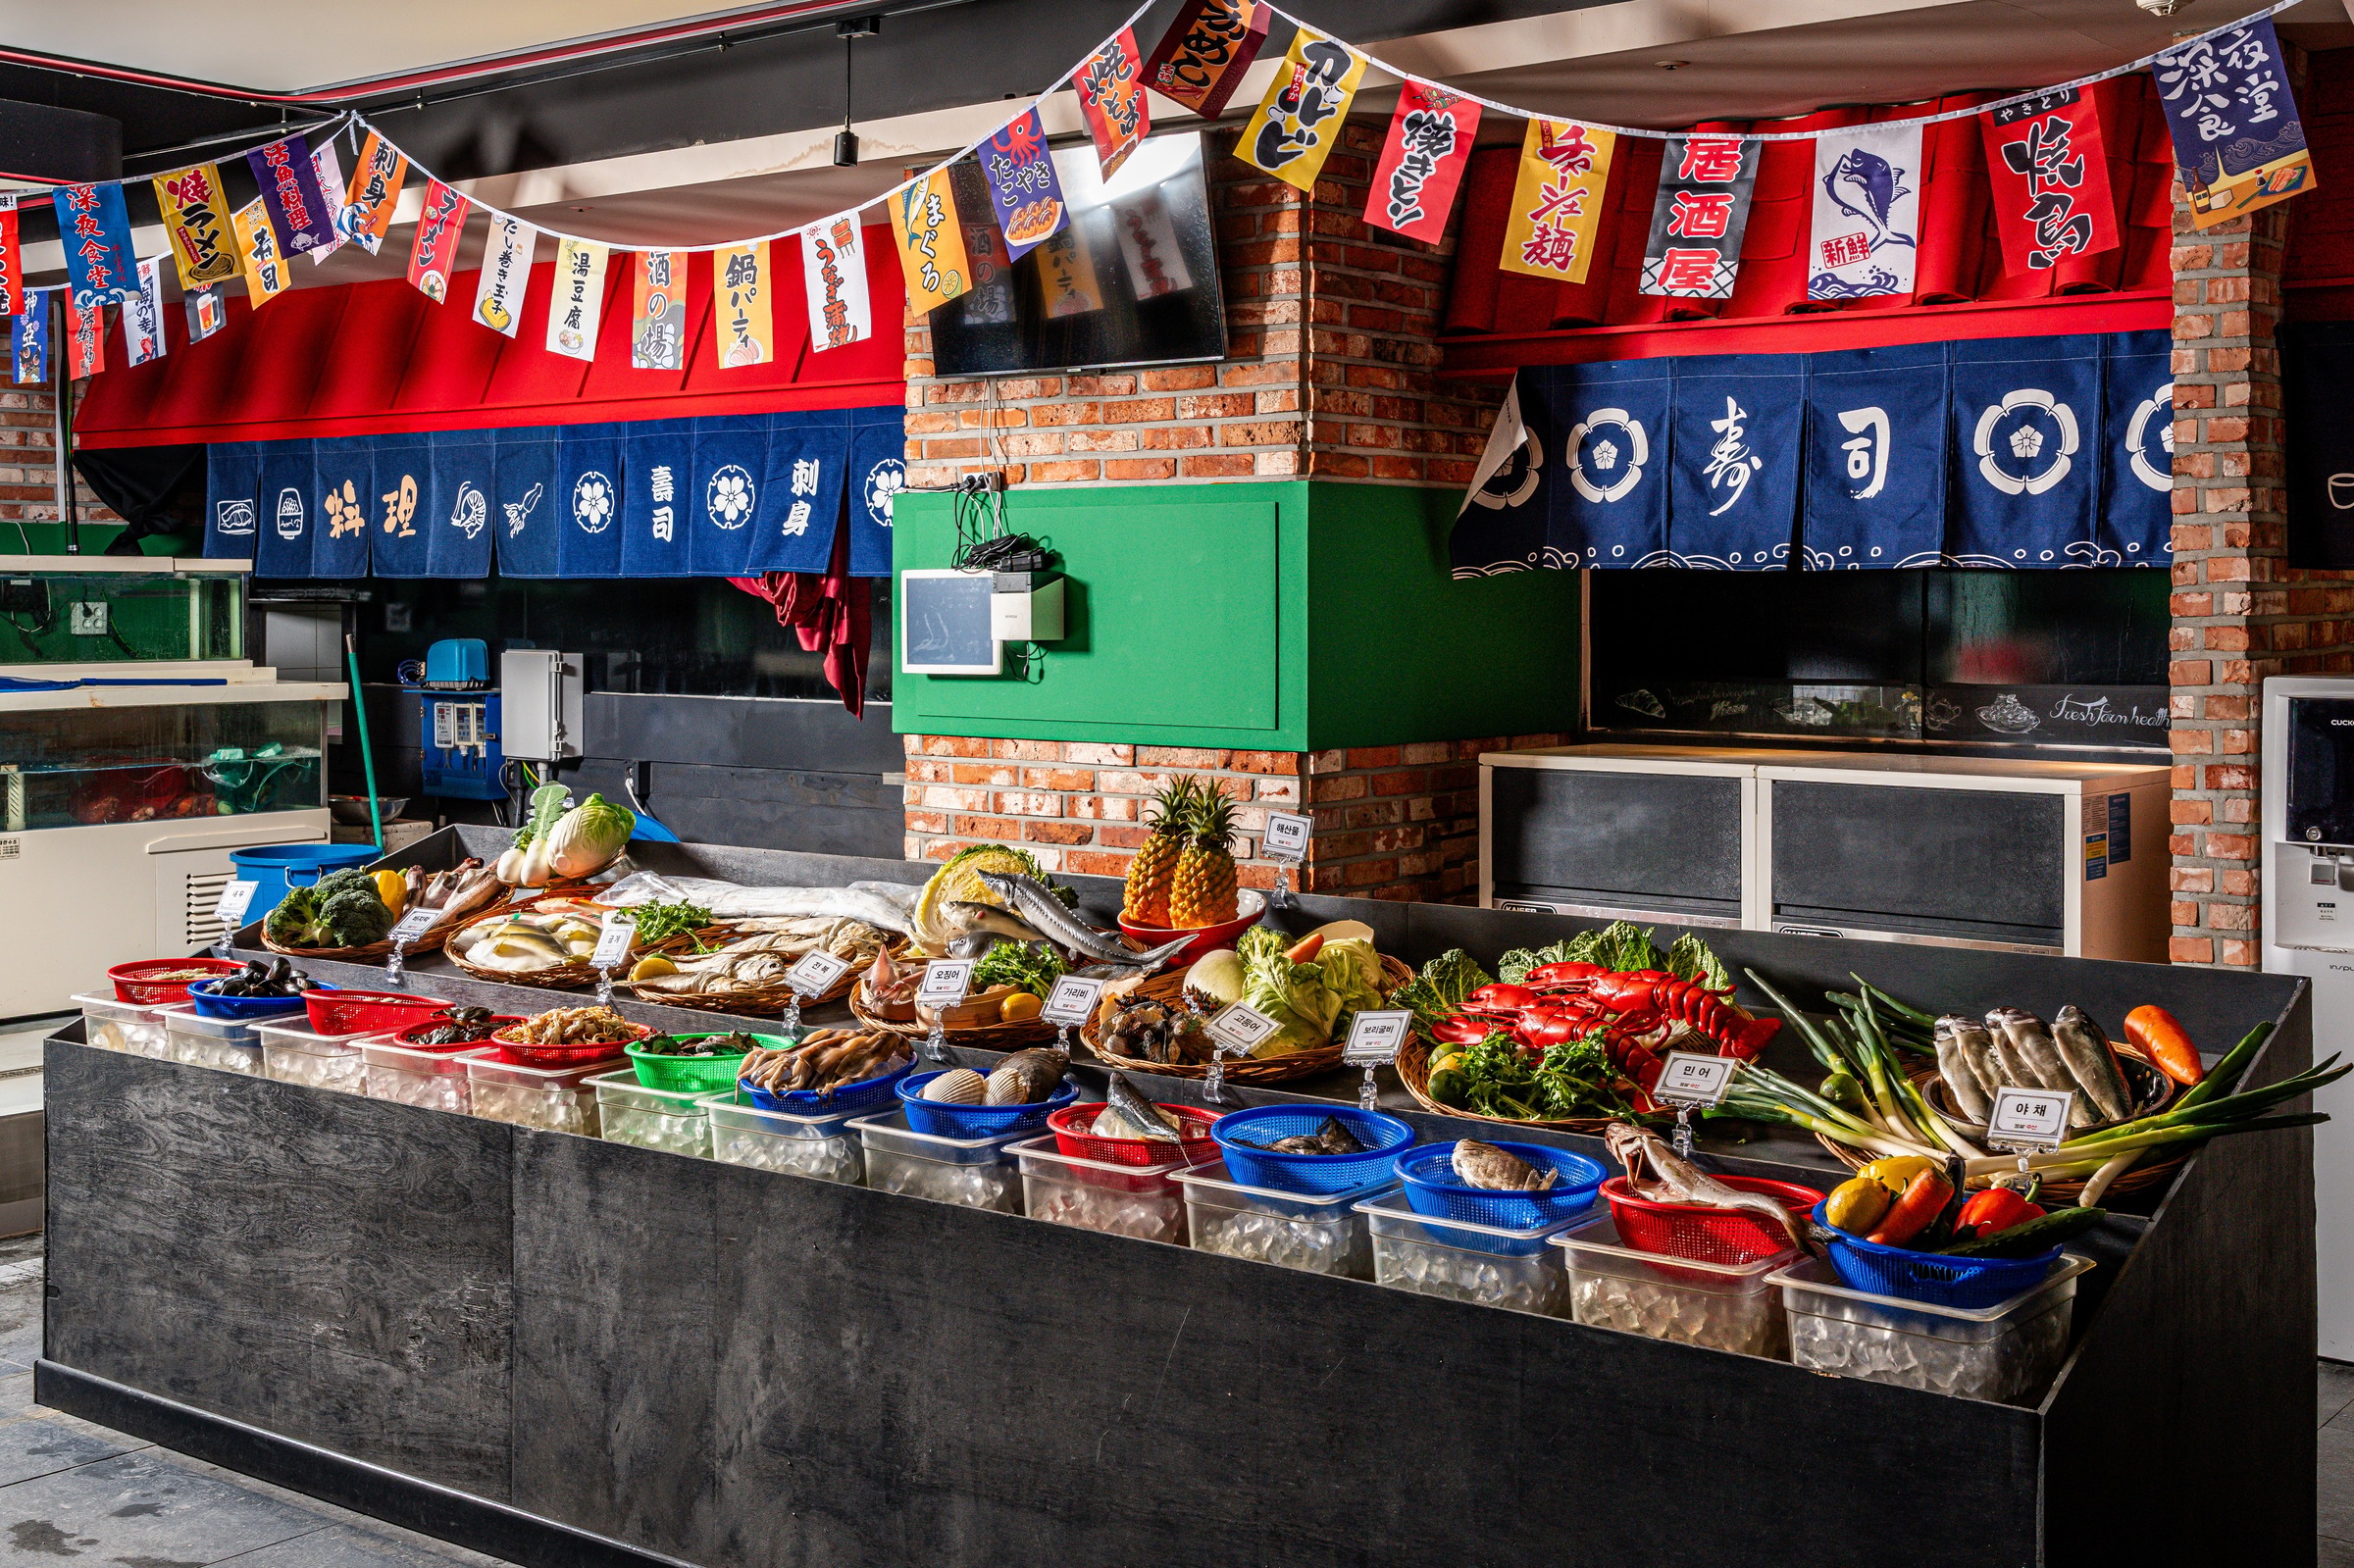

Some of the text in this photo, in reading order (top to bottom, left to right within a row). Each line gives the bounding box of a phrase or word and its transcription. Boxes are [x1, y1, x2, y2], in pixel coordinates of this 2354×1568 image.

[1083, 37, 1142, 137] 焼そば
[1158, 62, 1176, 83] 名物
[1254, 40, 1354, 171] カルビ
[1288, 64, 1305, 101] やわらか
[2000, 89, 2073, 122] やきとり
[263, 140, 312, 230] 活魚料理
[361, 140, 398, 210] 刺身
[2001, 116, 2093, 270] 焼鳥
[67, 183, 111, 288] 深夜食堂
[418, 188, 457, 267] ラーメン
[919, 193, 946, 292] まぐろ
[1658, 137, 1744, 293] 居酒屋
[1822, 234, 1869, 268] 新鮮
[563, 252, 590, 330] 湯豆腐
[643, 251, 671, 360] 酒の場
[725, 254, 757, 348] 鍋パーティ
[325, 475, 418, 538] 料理
[651, 466, 674, 542] 壽司
[783, 459, 819, 536] 刺身
[1277, 823, 1300, 836] 해산물
[935, 970, 960, 980] 오징어
[1063, 987, 1089, 999] 가리비
[1233, 1014, 1261, 1032] 고등어
